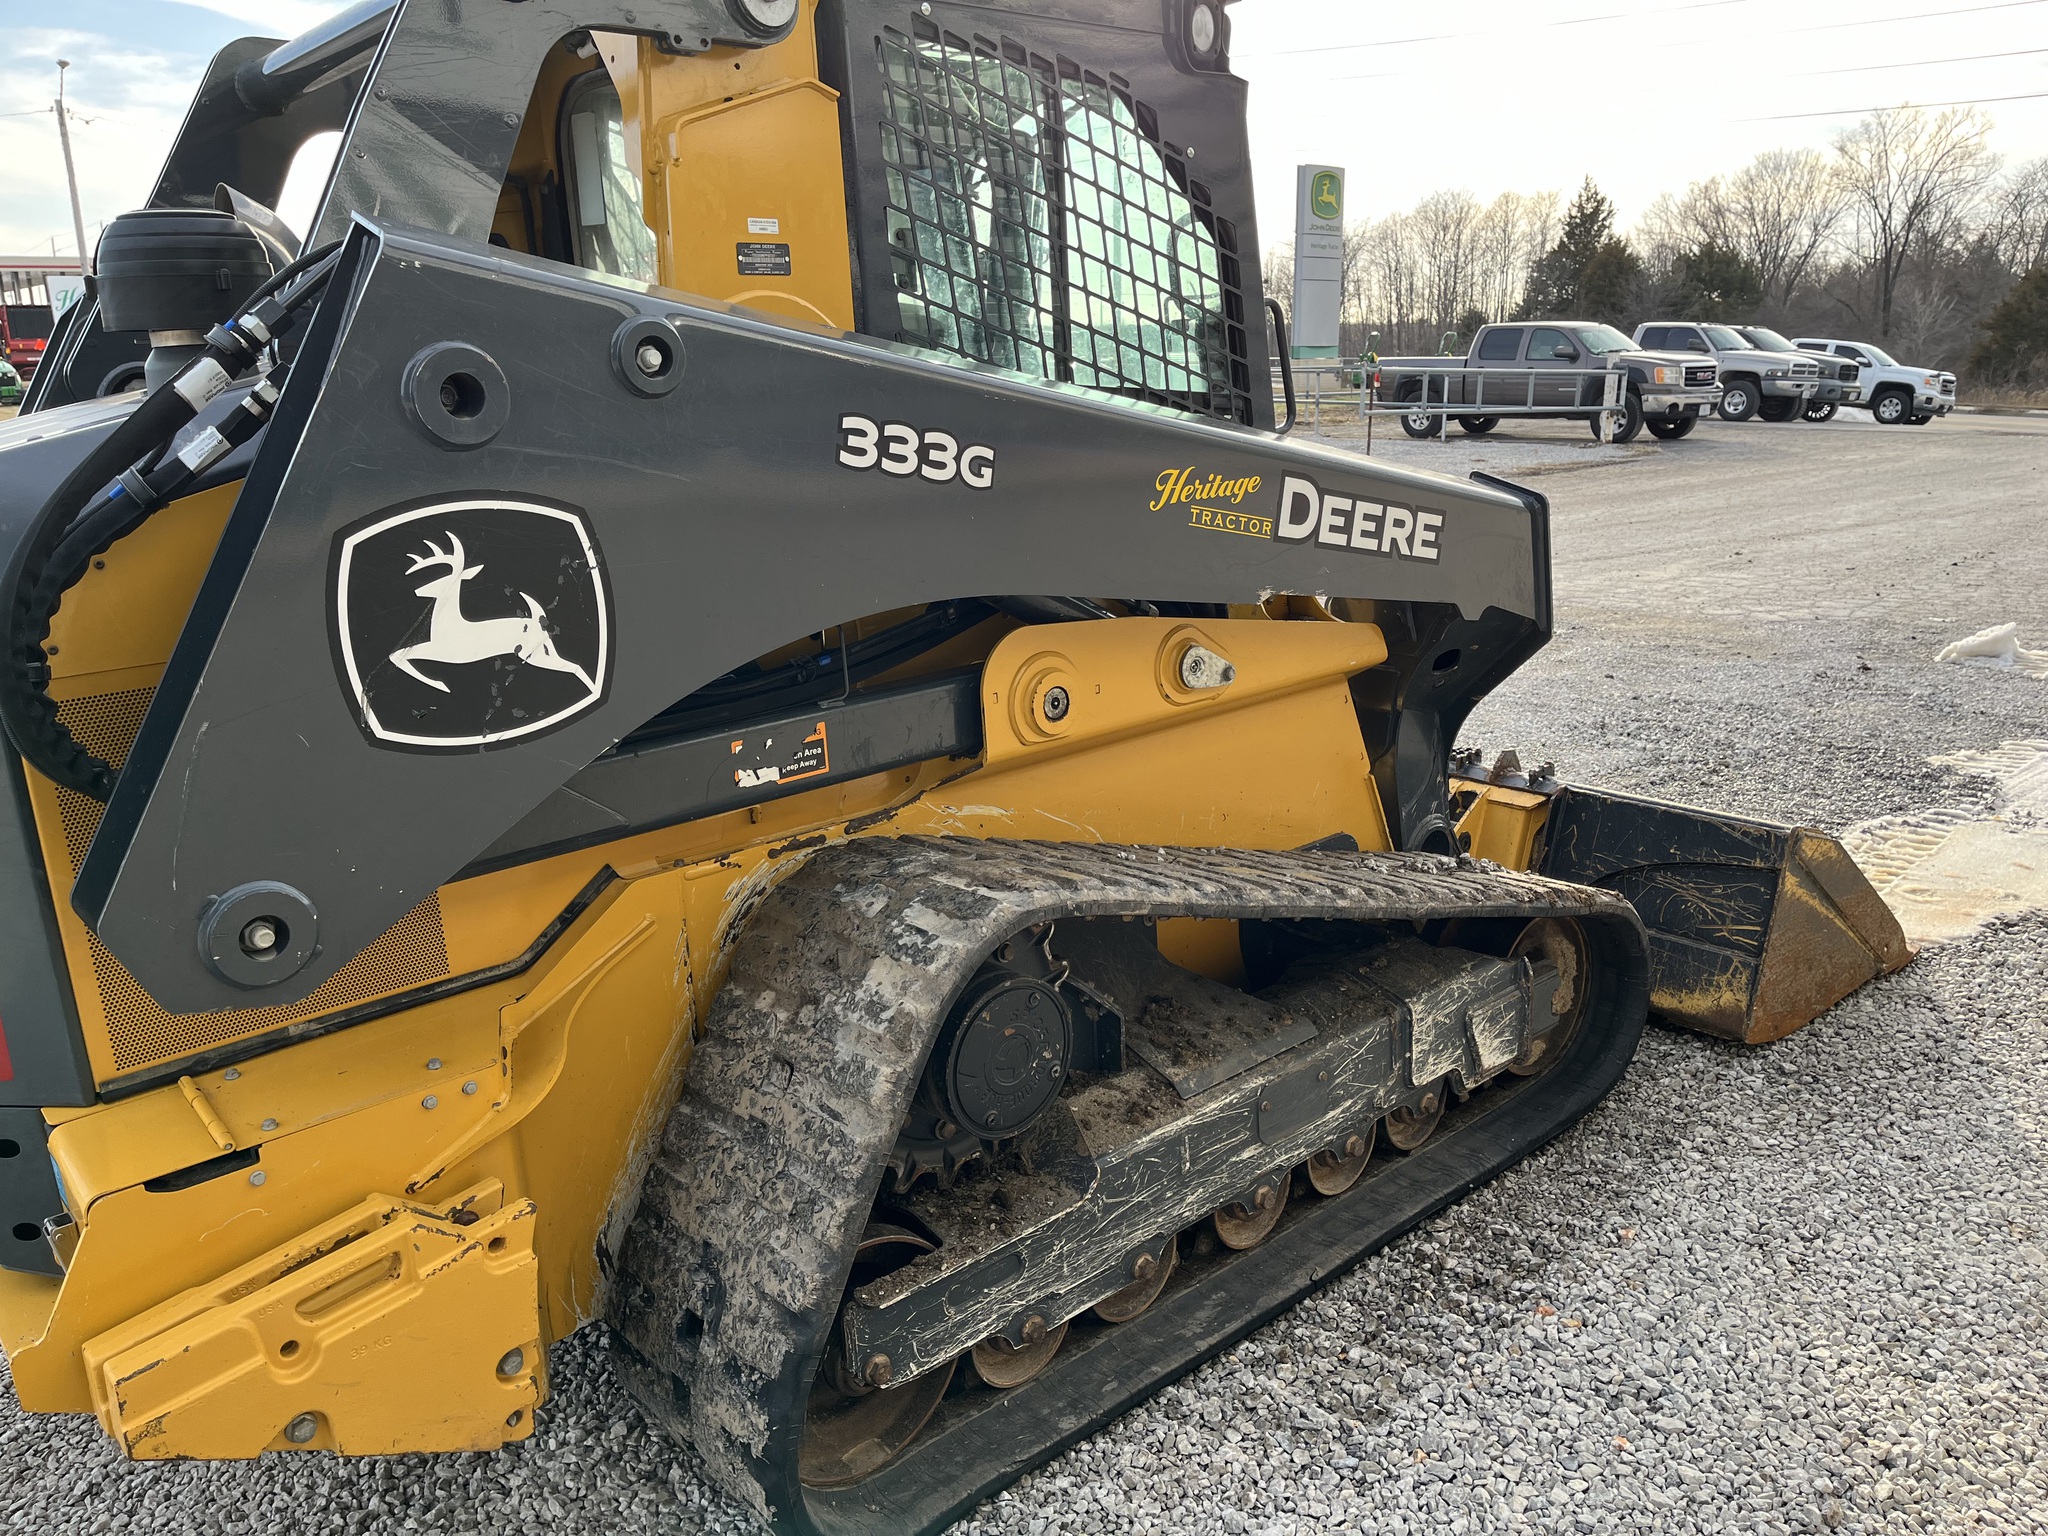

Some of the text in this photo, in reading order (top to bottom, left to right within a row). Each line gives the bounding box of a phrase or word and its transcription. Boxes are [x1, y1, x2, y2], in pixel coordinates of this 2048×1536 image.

[1309, 223, 1325, 231] JOHN
[839, 416, 994, 488] 333G
[1149, 466, 1262, 511] Heritage
[1190, 508, 1272, 536] TRACTOR
[1277, 476, 1443, 560] DEERE
[799, 758, 817, 768] Away
[804, 746, 822, 757] Area
[257, 1300, 285, 1319] USA
[350, 1335, 393, 1360] 39 KG
